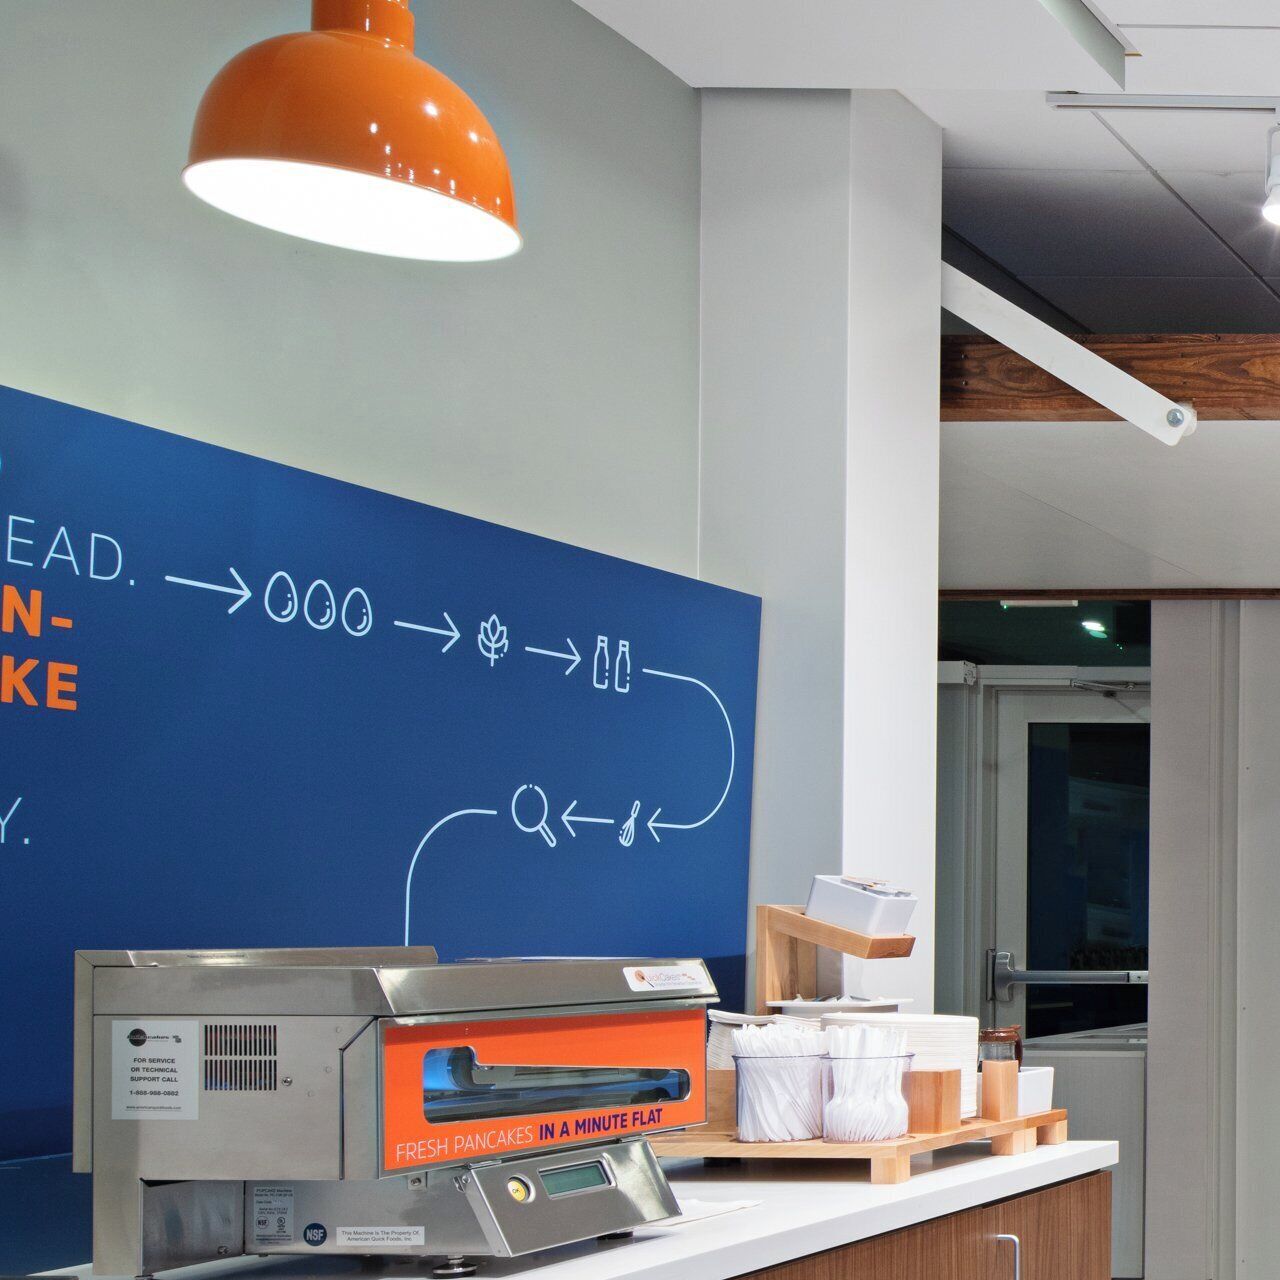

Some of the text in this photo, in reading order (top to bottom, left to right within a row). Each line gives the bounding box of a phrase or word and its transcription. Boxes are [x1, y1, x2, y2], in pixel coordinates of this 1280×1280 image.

[7, 515, 136, 586] EAD.
[0, 655, 78, 711] KE
[396, 1108, 663, 1162] FRESH PANCAKES IN A MINUTE FLAT
[306, 1229, 324, 1241] NSF
